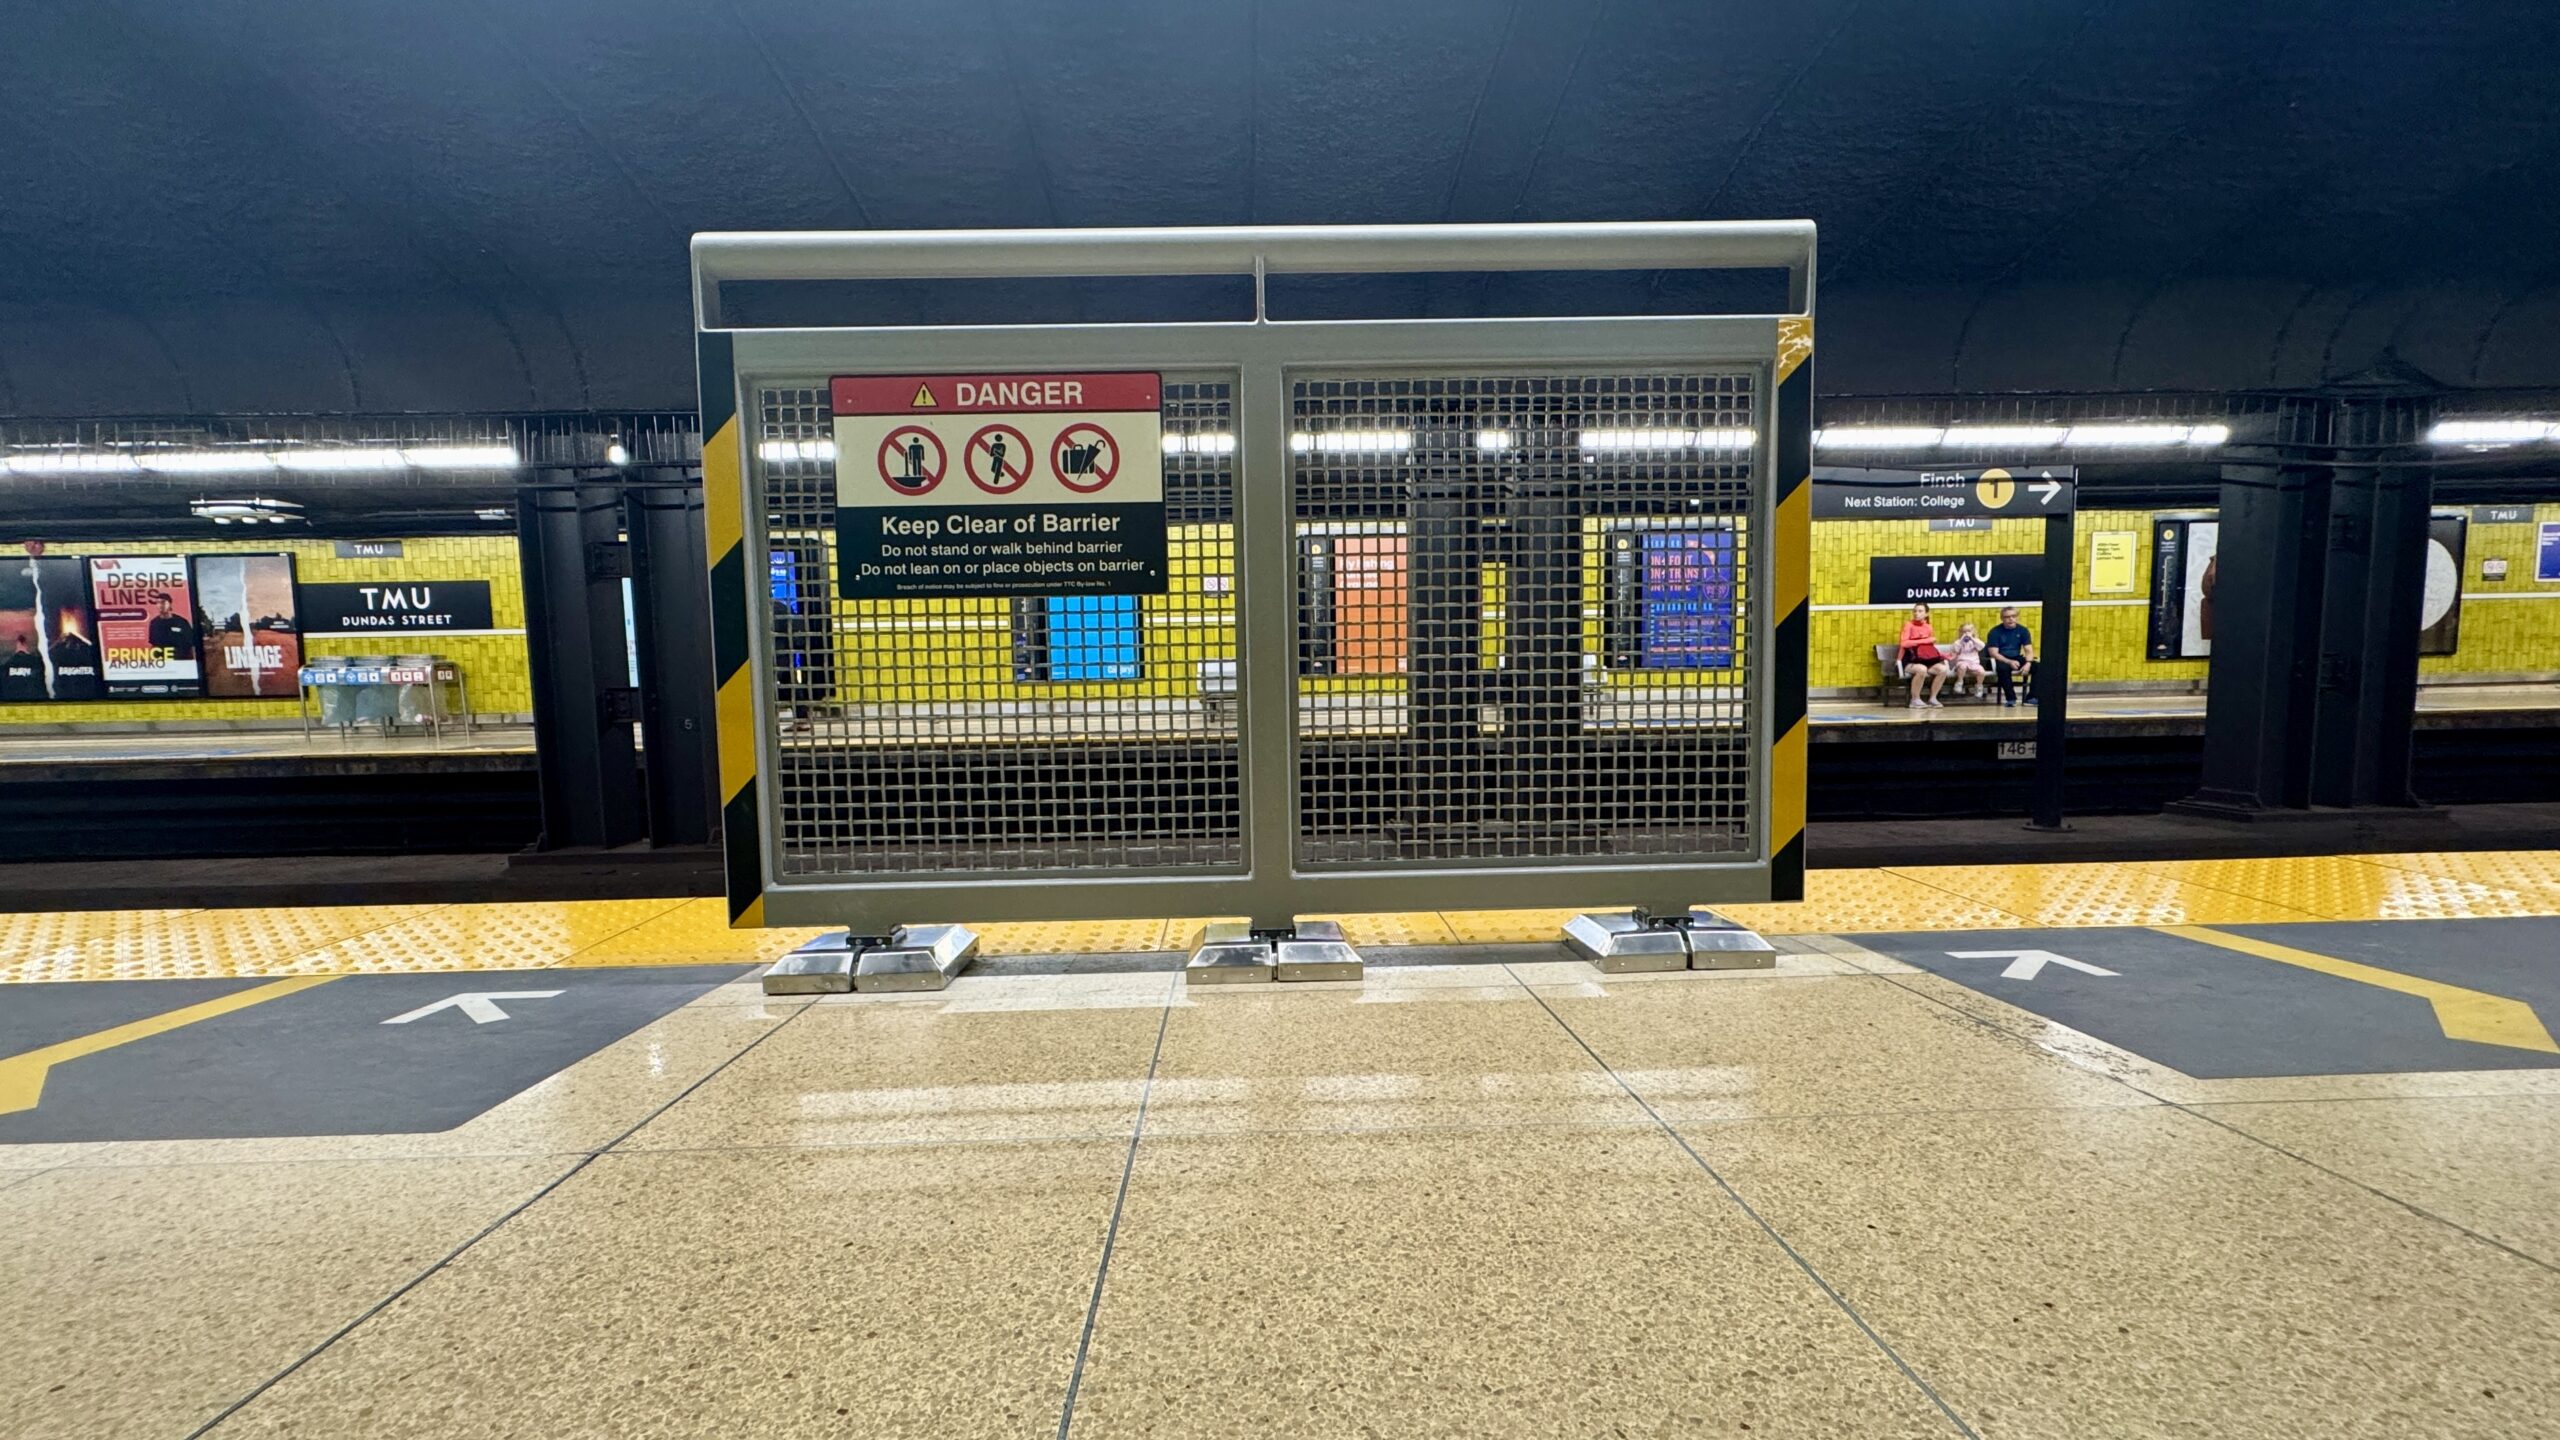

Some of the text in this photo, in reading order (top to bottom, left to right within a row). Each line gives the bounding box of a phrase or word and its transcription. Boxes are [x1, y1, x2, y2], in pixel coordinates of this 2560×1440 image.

[956, 381, 1083, 406] DANGER
[1920, 473, 1966, 488] Finch
[1845, 495, 1965, 509] Next Station: College
[1948, 518, 1975, 528] TMU
[2490, 511, 2517, 520] TMU
[882, 513, 1121, 539] Keep Clear of Barrier
[354, 544, 384, 555] TMU
[882, 541, 1123, 557] Do not stand or walk behind barrier
[861, 560, 1145, 577] Do not lean on or place objects on barrier
[1927, 560, 1993, 583] TMU
[107, 572, 184, 588] DESIRE
[101, 589, 160, 606] LINES
[359, 587, 431, 610] TMU
[1907, 587, 2010, 598] DUNDAS STREET
[342, 614, 452, 626] DUNDAS STREET
[108, 647, 175, 662] PRINCE
[109, 660, 166, 669] AMOAKO
